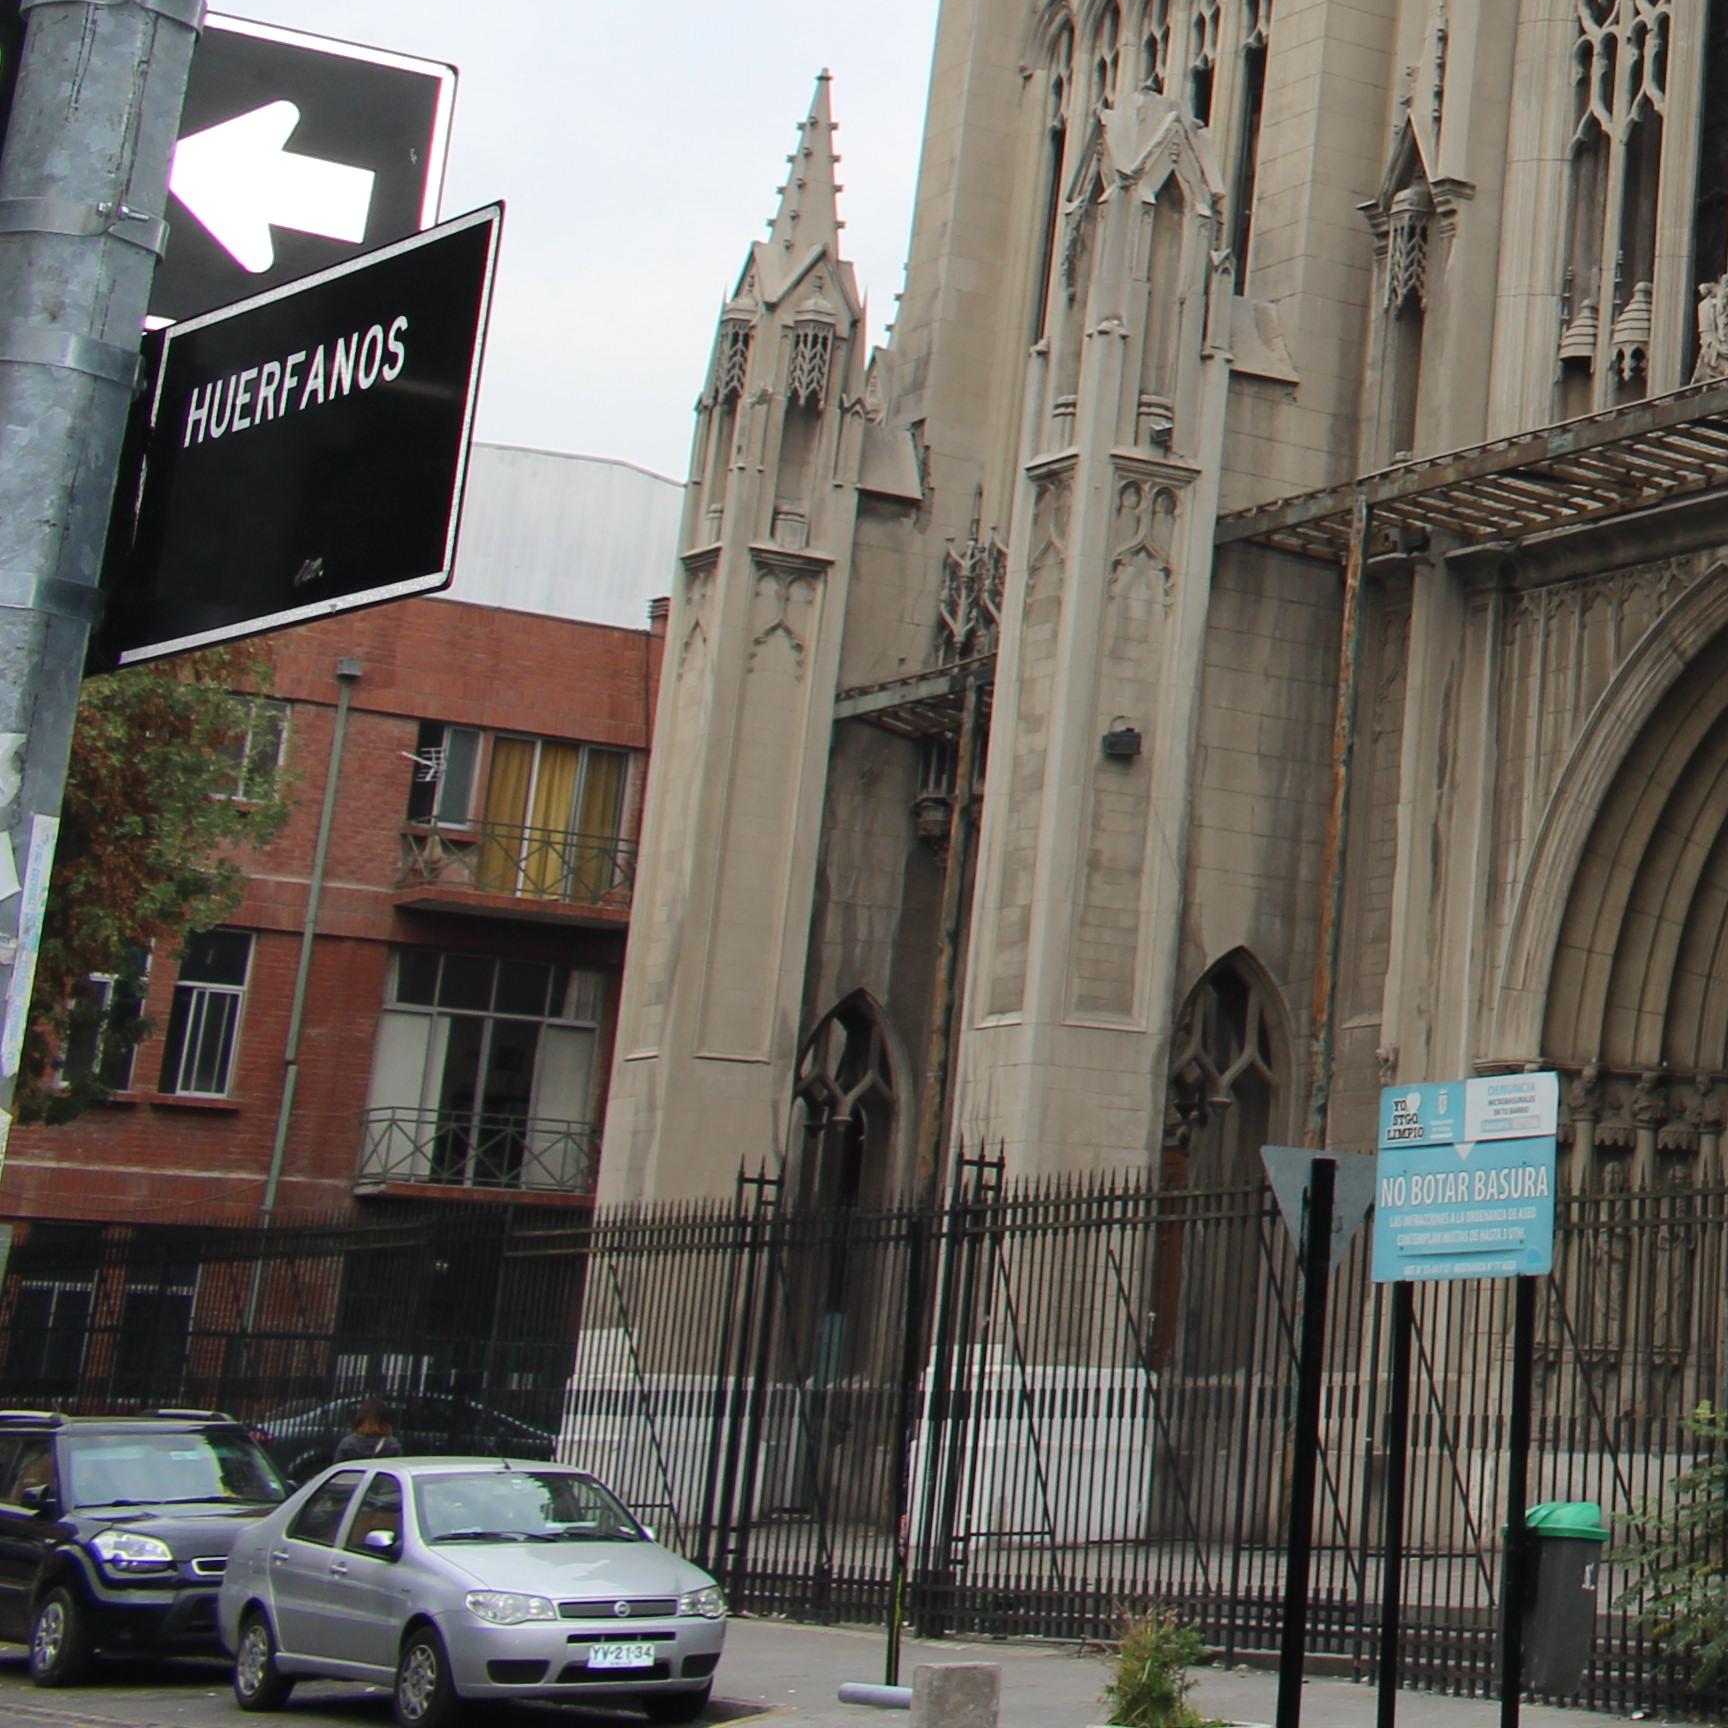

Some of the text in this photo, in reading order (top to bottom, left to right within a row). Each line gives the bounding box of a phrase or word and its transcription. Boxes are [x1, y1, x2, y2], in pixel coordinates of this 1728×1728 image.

[183, 315, 408, 448] HUERFANOS
[1488, 1083, 1536, 1096] DENUNCIA
[1393, 1099, 1407, 1112] YO
[1392, 1113, 1418, 1125] STGO
[1386, 1126, 1424, 1140] LIMPIO
[1380, 1165, 1548, 1208] NO BOTAR BASURA
[1464, 1209, 1506, 1223] ORDENANZA
[1507, 1207, 1517, 1220] DE
[1519, 1206, 1536, 1219] ASEO
[1480, 1228, 1501, 1241] HASTA
